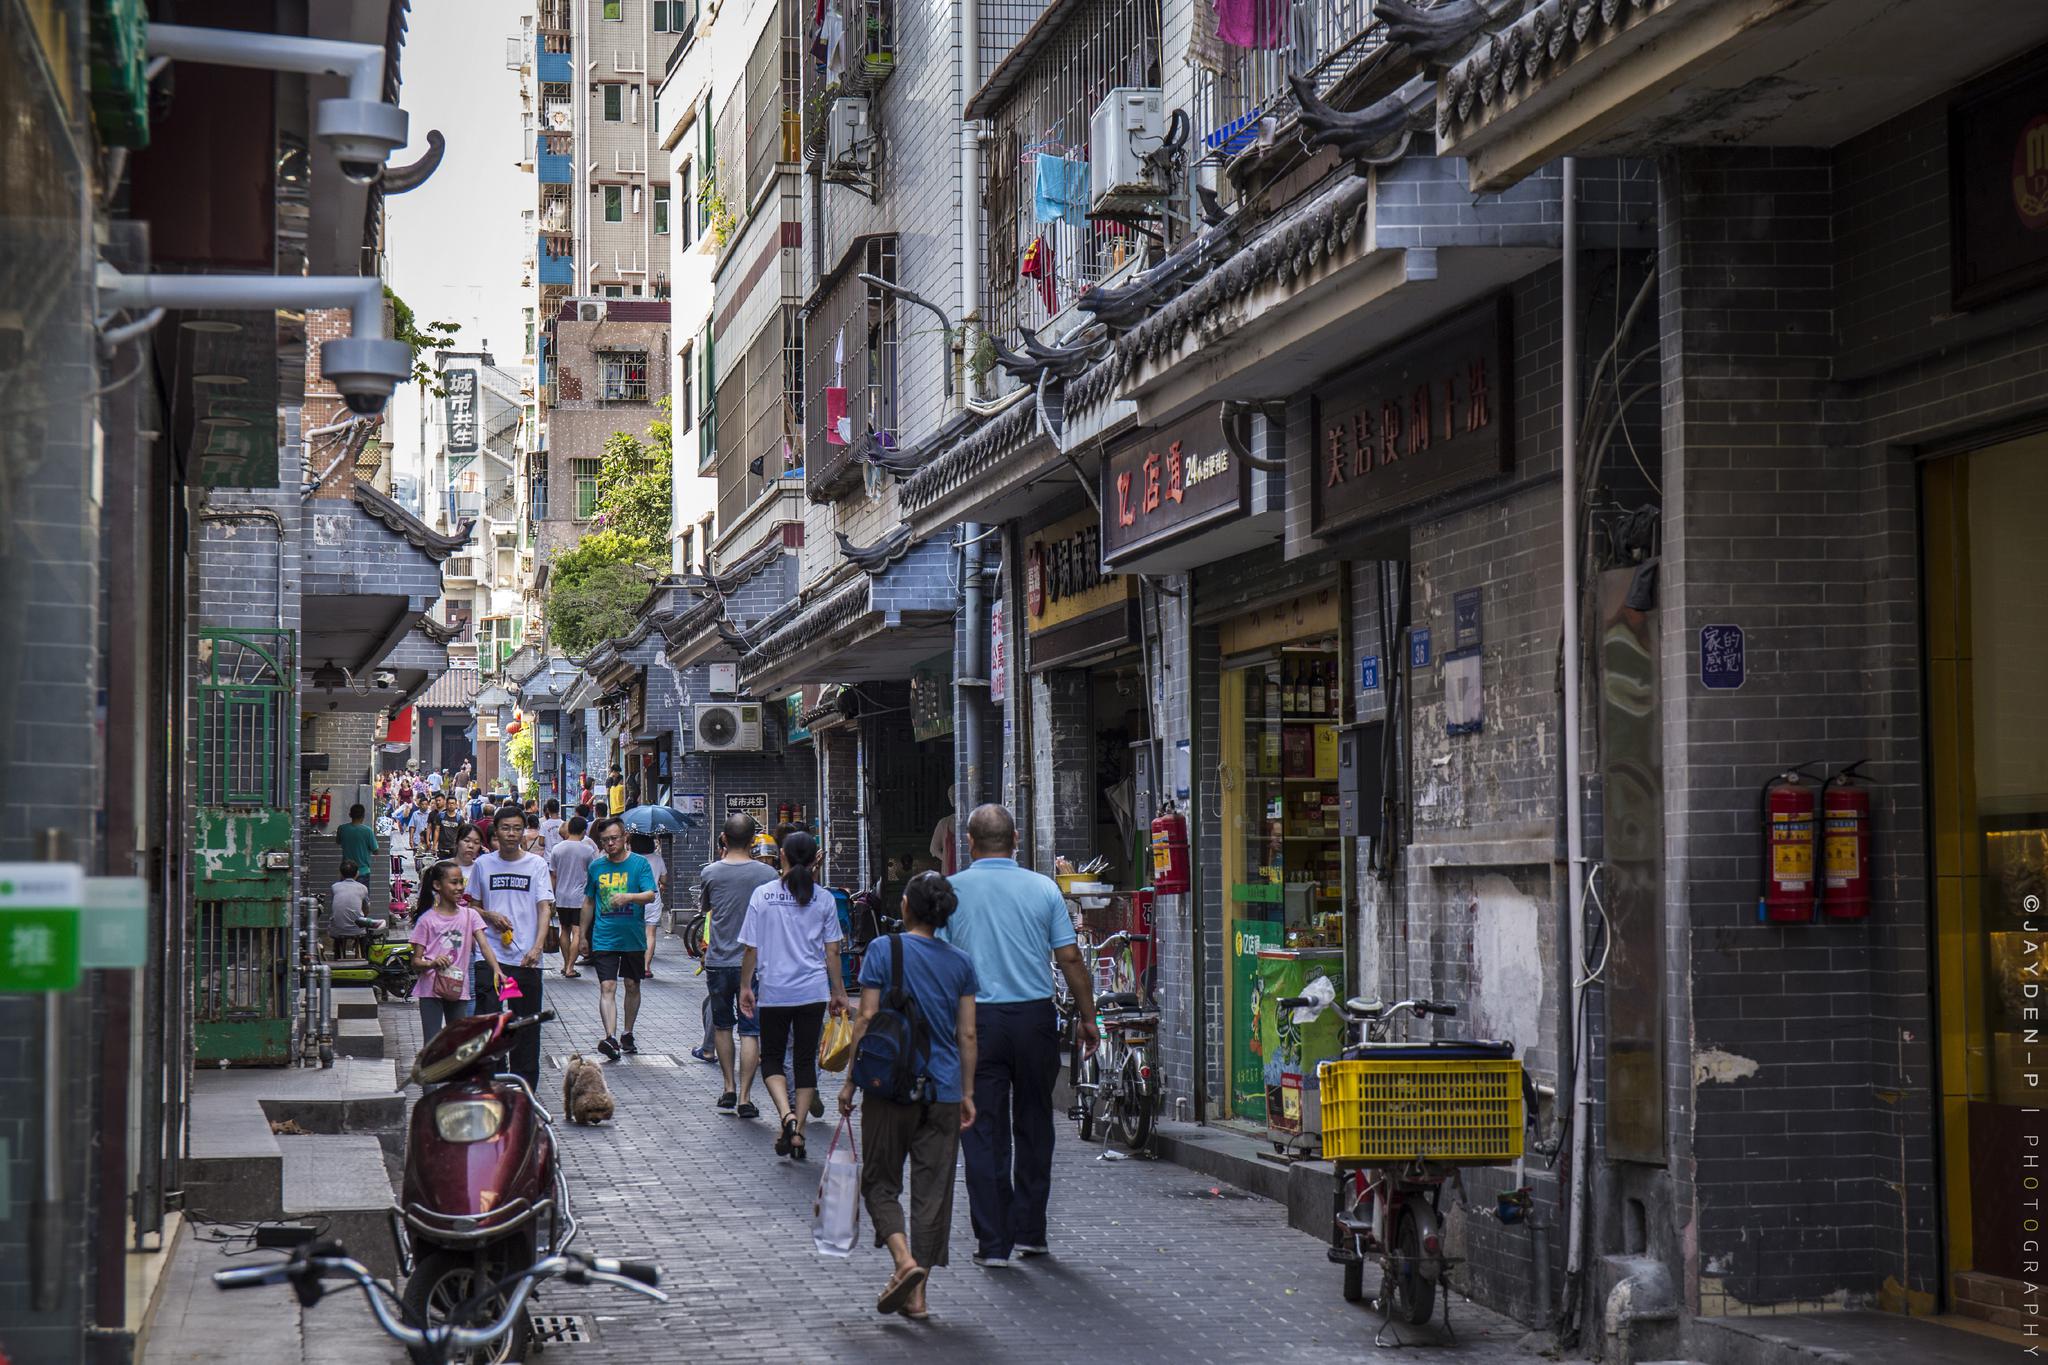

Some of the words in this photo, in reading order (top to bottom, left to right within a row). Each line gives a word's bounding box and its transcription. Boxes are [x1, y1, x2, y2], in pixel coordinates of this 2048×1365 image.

[449, 373, 473, 447] 城市共生
[1117, 440, 1185, 528] 亿店通
[1704, 627, 1740, 651] 家的
[1415, 644, 1424, 665] 36
[1365, 669, 1374, 686] 38
[728, 797, 764, 807] 城市共生
[492, 876, 510, 888] BEST
[510, 877, 528, 889] HOOP
